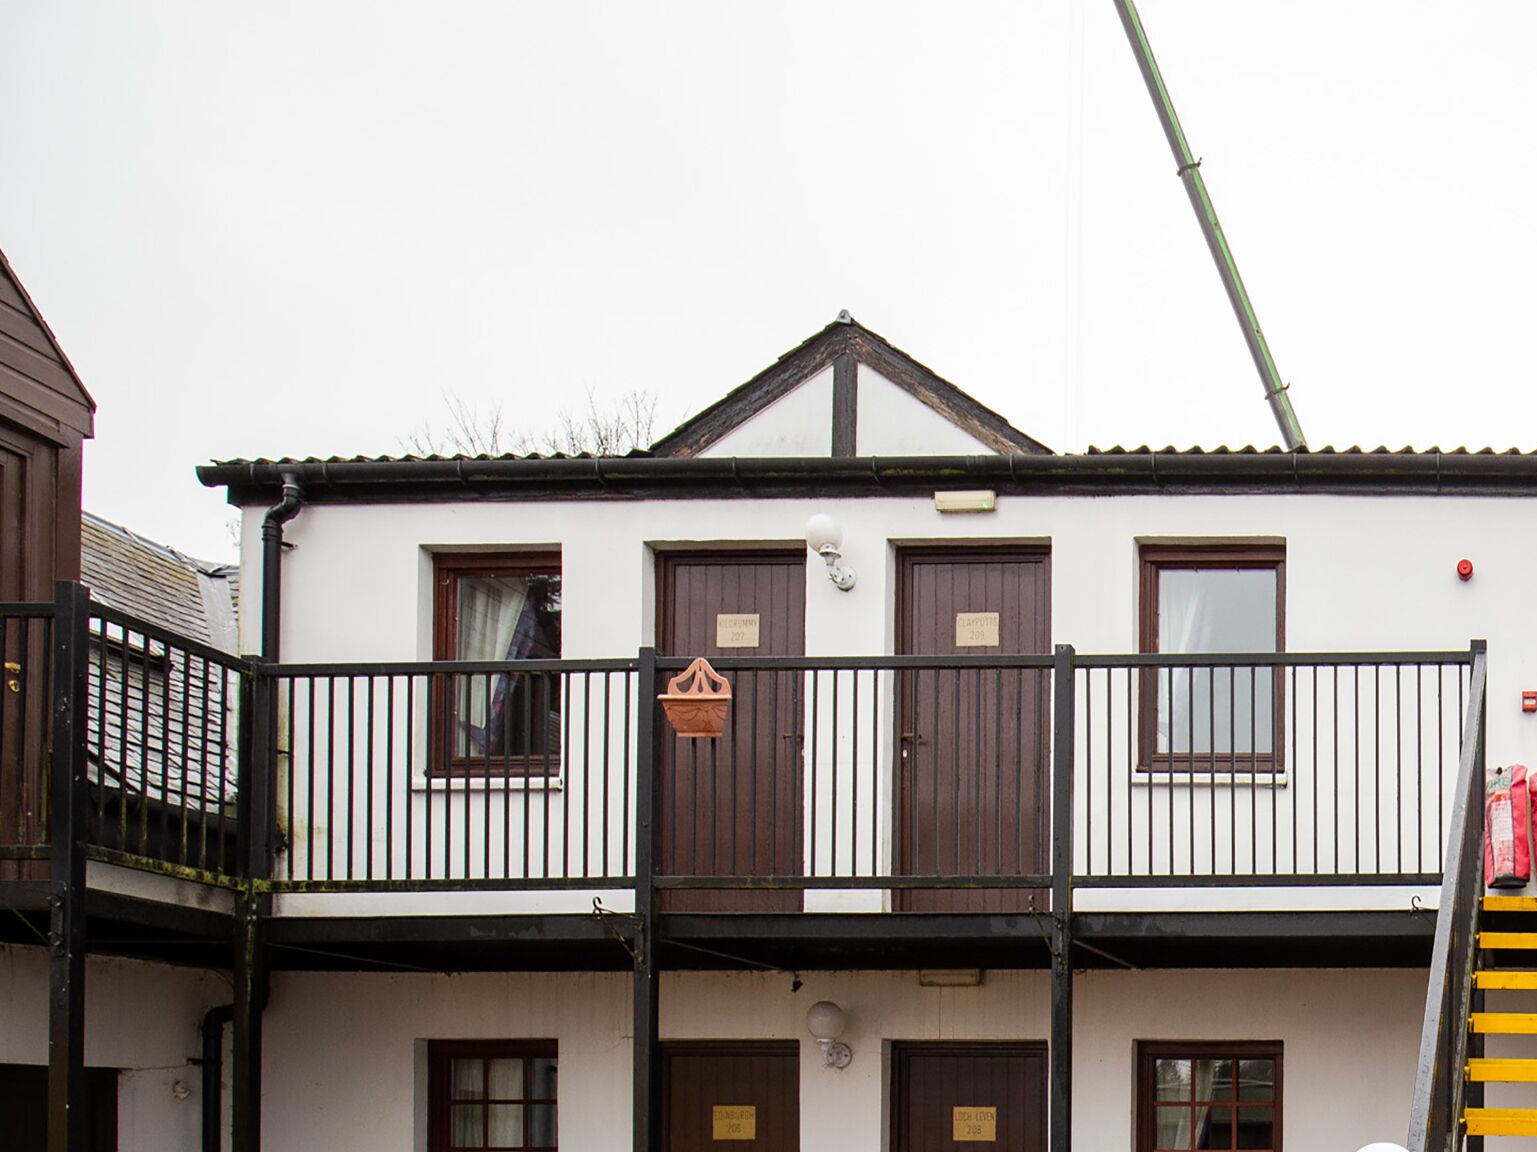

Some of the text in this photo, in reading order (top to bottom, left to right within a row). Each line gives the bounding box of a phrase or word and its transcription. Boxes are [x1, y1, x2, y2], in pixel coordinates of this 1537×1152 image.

[714, 1109, 754, 1121] EDINBURGH
[955, 1111, 995, 1122] LOCH LEVEN
